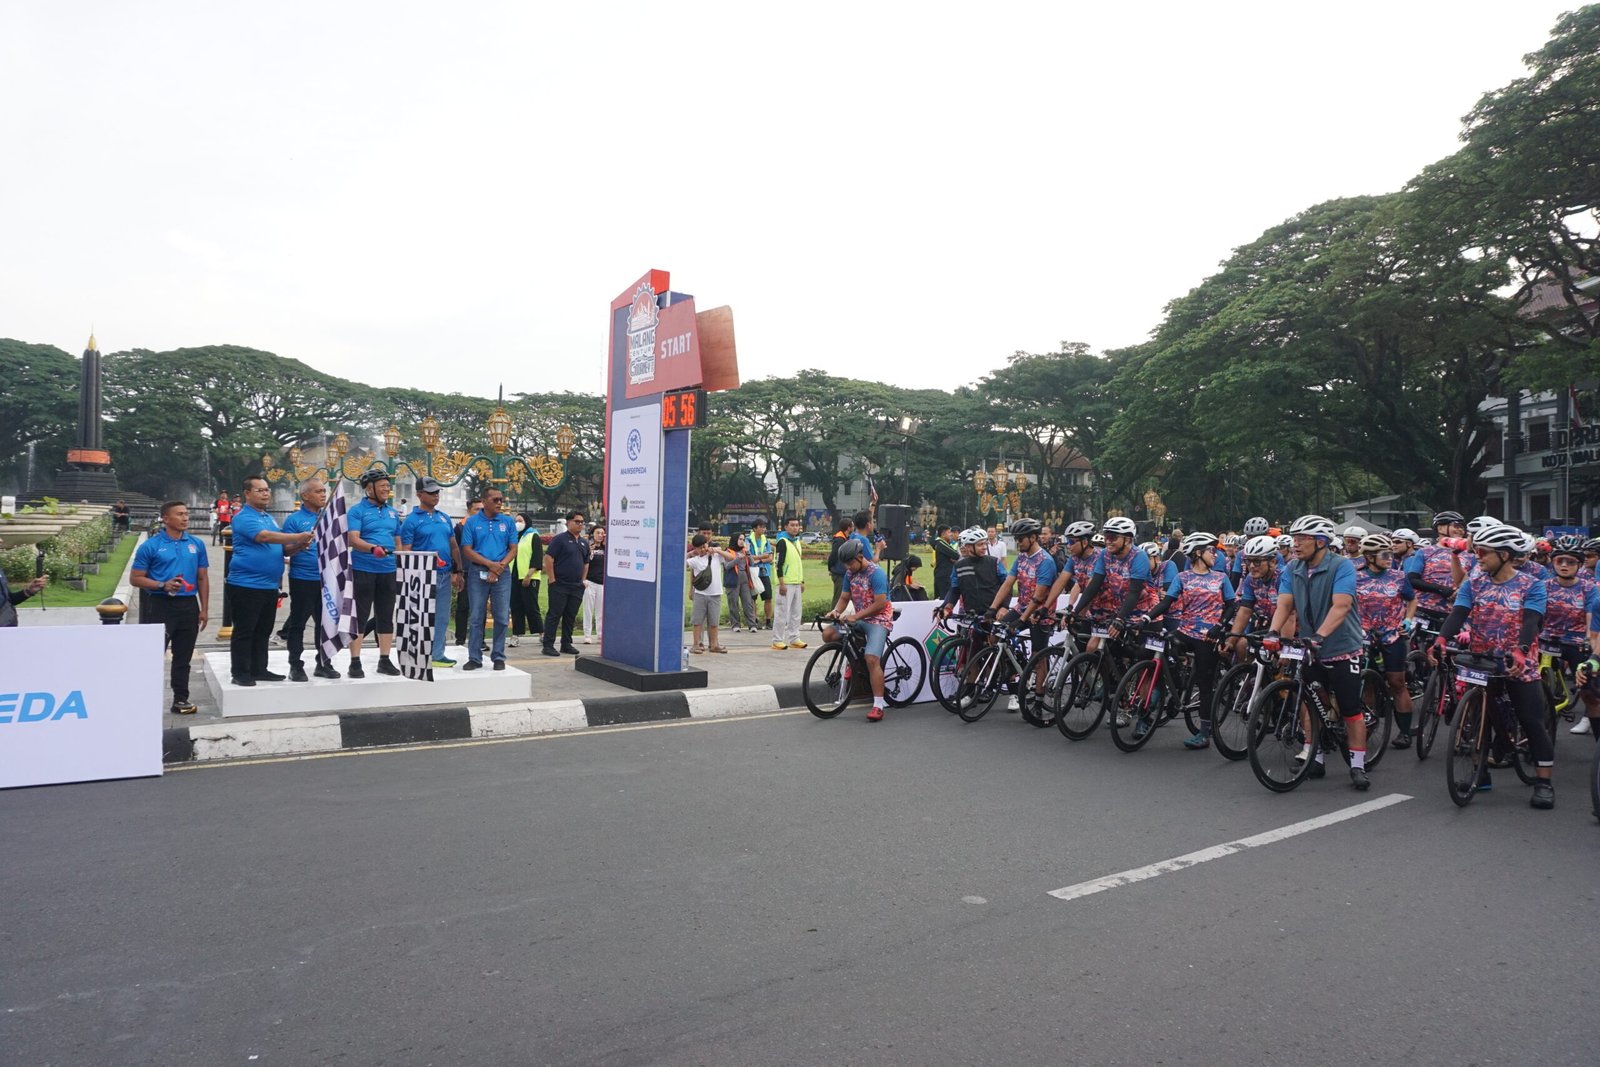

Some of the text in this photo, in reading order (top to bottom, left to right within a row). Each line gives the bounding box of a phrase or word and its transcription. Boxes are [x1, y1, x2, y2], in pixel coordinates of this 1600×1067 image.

[631, 329, 655, 350] MALANG
[660, 332, 692, 360] START
[663, 394, 695, 428] 05 56
[620, 466, 647, 475] MAINSEPEDA
[610, 519, 640, 527] AZAWEAR.COM
[408, 574, 421, 666] START
[1469, 671, 1486, 680] 782
